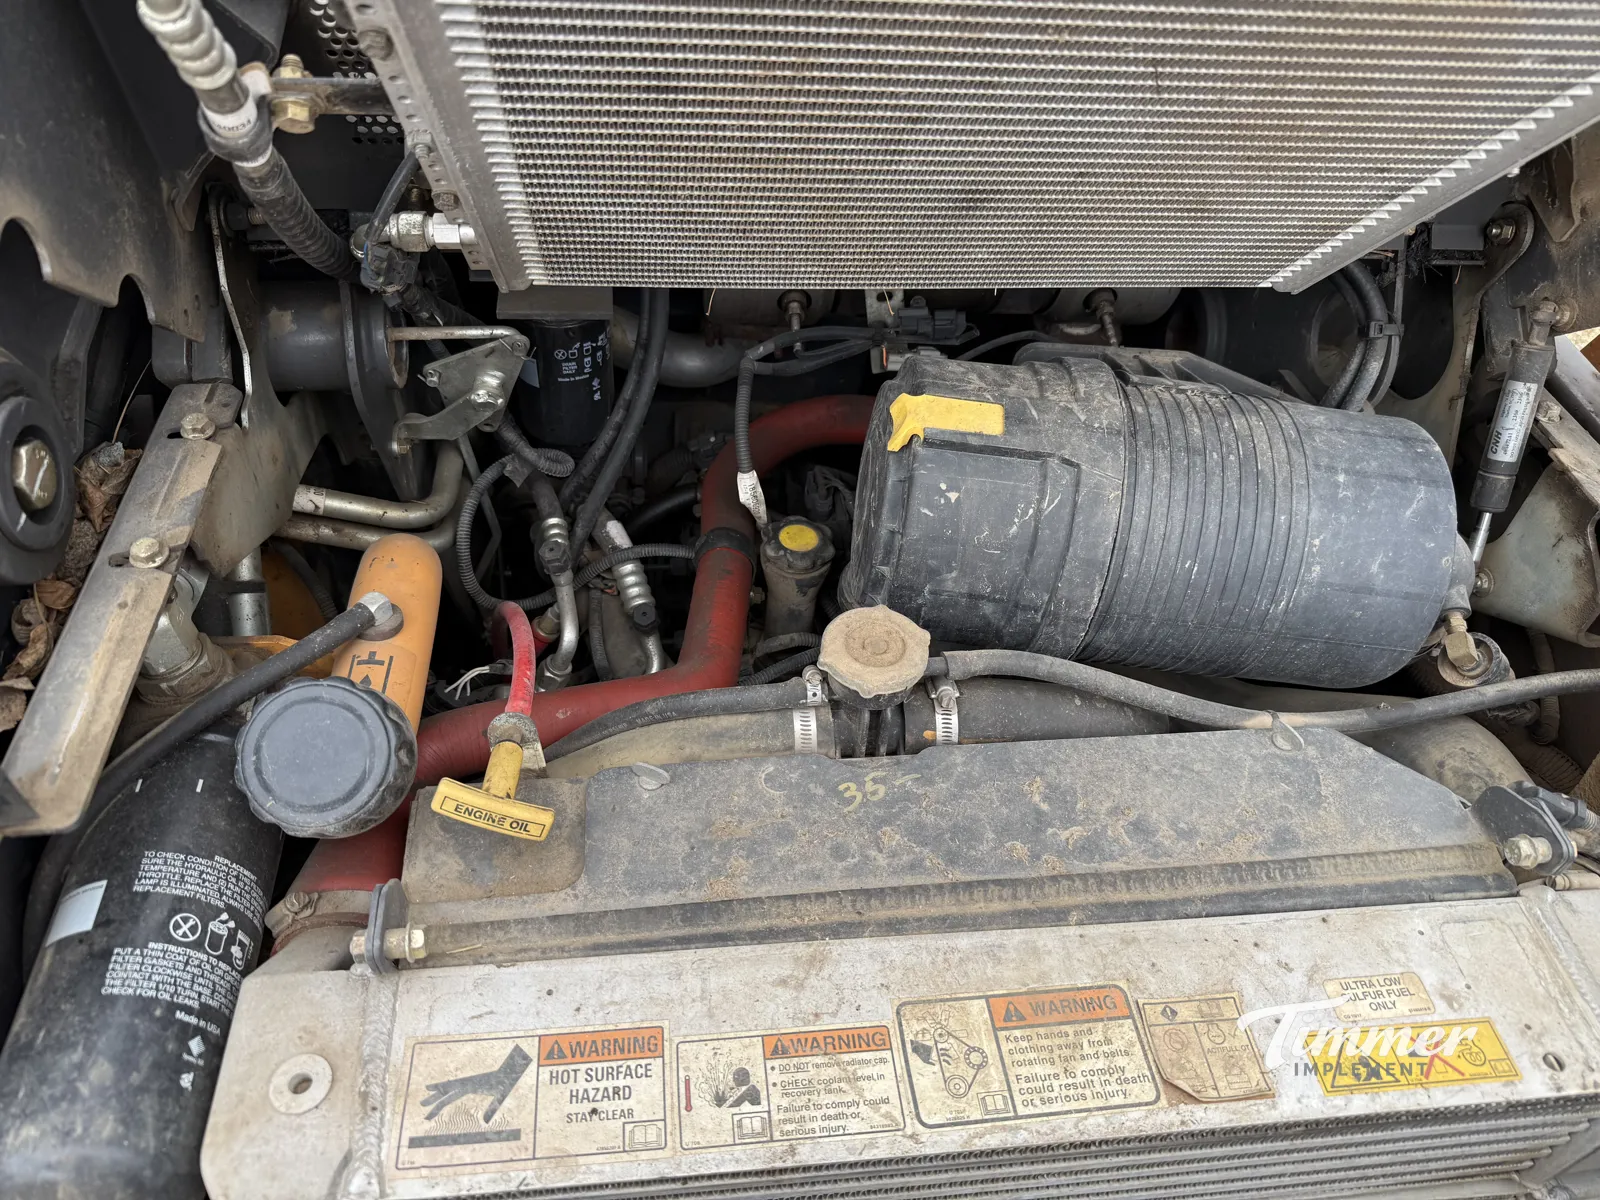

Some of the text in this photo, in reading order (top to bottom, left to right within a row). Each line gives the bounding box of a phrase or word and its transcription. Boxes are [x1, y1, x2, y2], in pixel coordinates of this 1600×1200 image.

[1490, 430, 1502, 454] CNH
[454, 803, 531, 833] ENGINE OIL
[156, 851, 186, 860] CHECK
[187, 855, 229, 872] CONDITION
[166, 858, 184, 866] THE
[184, 862, 227, 878] HYDRAULIC
[228, 875, 238, 884] OIL
[214, 855, 258, 882] REPLACEMENT
[140, 864, 200, 878] TEMPERATURE
[201, 873, 218, 882] AND
[218, 878, 228, 888] (2)
[132, 885, 226, 910] REPLACEMENT FILTERS.
[184, 876, 220, 892] REPLACE
[220, 887, 234, 898] THE
[221, 895, 245, 912] ALWAYS
[113, 948, 134, 956] PUT
[133, 948, 141, 956] A
[143, 948, 164, 958] THIN
[164, 952, 188, 962] COAT
[189, 958, 200, 966] OF
[201, 962, 212, 972] OIL
[214, 967, 224, 977] OR
[148, 942, 208, 962] INSTRUCTIONS
[208, 956, 218, 966] TO
[106, 970, 150, 980] CONTACT
[152, 974, 176, 984] WITH
[176, 977, 192, 988] THE
[108, 962, 226, 996] FILTER CLOCKWISE UNTIL THE
[110, 954, 142, 963] FILTER
[144, 956, 184, 970] GASKETS
[185, 965, 202, 976] AND
[203, 970, 232, 990] THREADS
[1340, 976, 1401, 991] ULTRA LOW
[1386, 987, 1416, 998] FUEL
[100, 986, 200, 1010] CHECK FOR OIL LEAKS.
[124, 979, 156, 990] FILTER
[158, 982, 176, 994] 1/10
[200, 994, 221, 1010] START
[1028, 994, 1118, 1017] WARNING
[1368, 1000, 1398, 1012] ONLY
[175, 1010, 220, 1036] Made in USA
[790, 1032, 886, 1053] WARNING
[1005, 1027, 1093, 1044] Keep hands and
[569, 1035, 658, 1058] WARNING
[1008, 1037, 1113, 1056] clothing away from
[778, 1057, 890, 1072] DO NOT remove radiator cap.
[1012, 1054, 1056, 1067] rotating
[1058, 1052, 1076, 1063] fan
[1080, 1049, 1100, 1060] and
[549, 1063, 652, 1085] HOT SURFACE
[780, 1077, 814, 1089] CHECK
[817, 1076, 851, 1085] coolant
[1015, 1064, 1126, 1084] Failure to comply
[1018, 1072, 1150, 1096] could result in death
[570, 1086, 632, 1104] HAZARD
[781, 1088, 820, 1098] recovery
[1021, 1087, 1131, 1108] or serious injury.
[777, 1096, 890, 1114] Failure to comply could
[566, 1108, 634, 1124] STAY CLEAR
[779, 1114, 805, 1125] result
[809, 1114, 818, 1122] in
[821, 1111, 848, 1121] death
[779, 1124, 849, 1137] serious injury.
